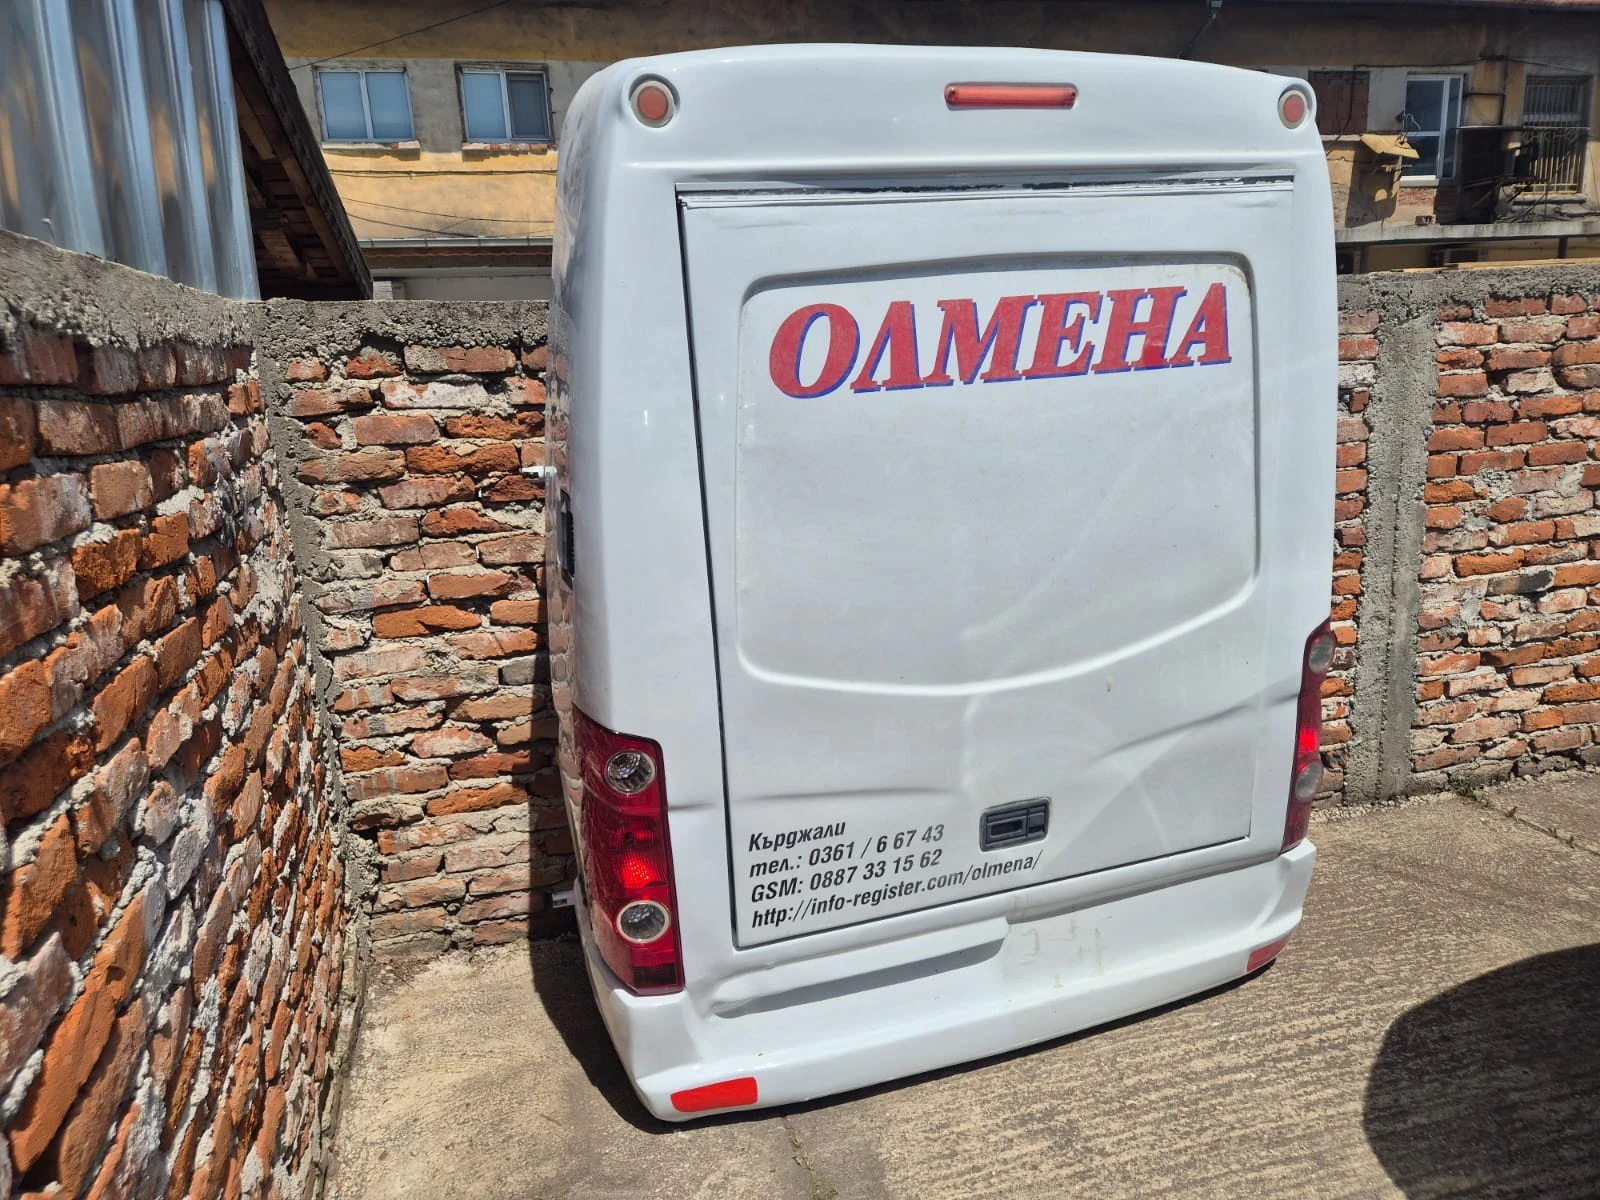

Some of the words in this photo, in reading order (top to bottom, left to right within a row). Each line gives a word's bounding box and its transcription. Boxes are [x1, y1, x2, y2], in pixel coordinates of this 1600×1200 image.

[769, 282, 1232, 399] ОЛМЕНА
[749, 821, 847, 852] Кърджали
[809, 842, 855, 867] 0361
[860, 837, 872, 858] /
[876, 835, 888, 853] 6
[893, 830, 916, 850] 67
[921, 824, 945, 843] 43
[751, 879, 803, 903] GSM:
[809, 866, 857, 891] 0887
[862, 861, 885, 881] 33
[893, 855, 914, 874] 15
[919, 849, 943, 869] 62
[751, 849, 1043, 928] http://info-register.com/olmena/
